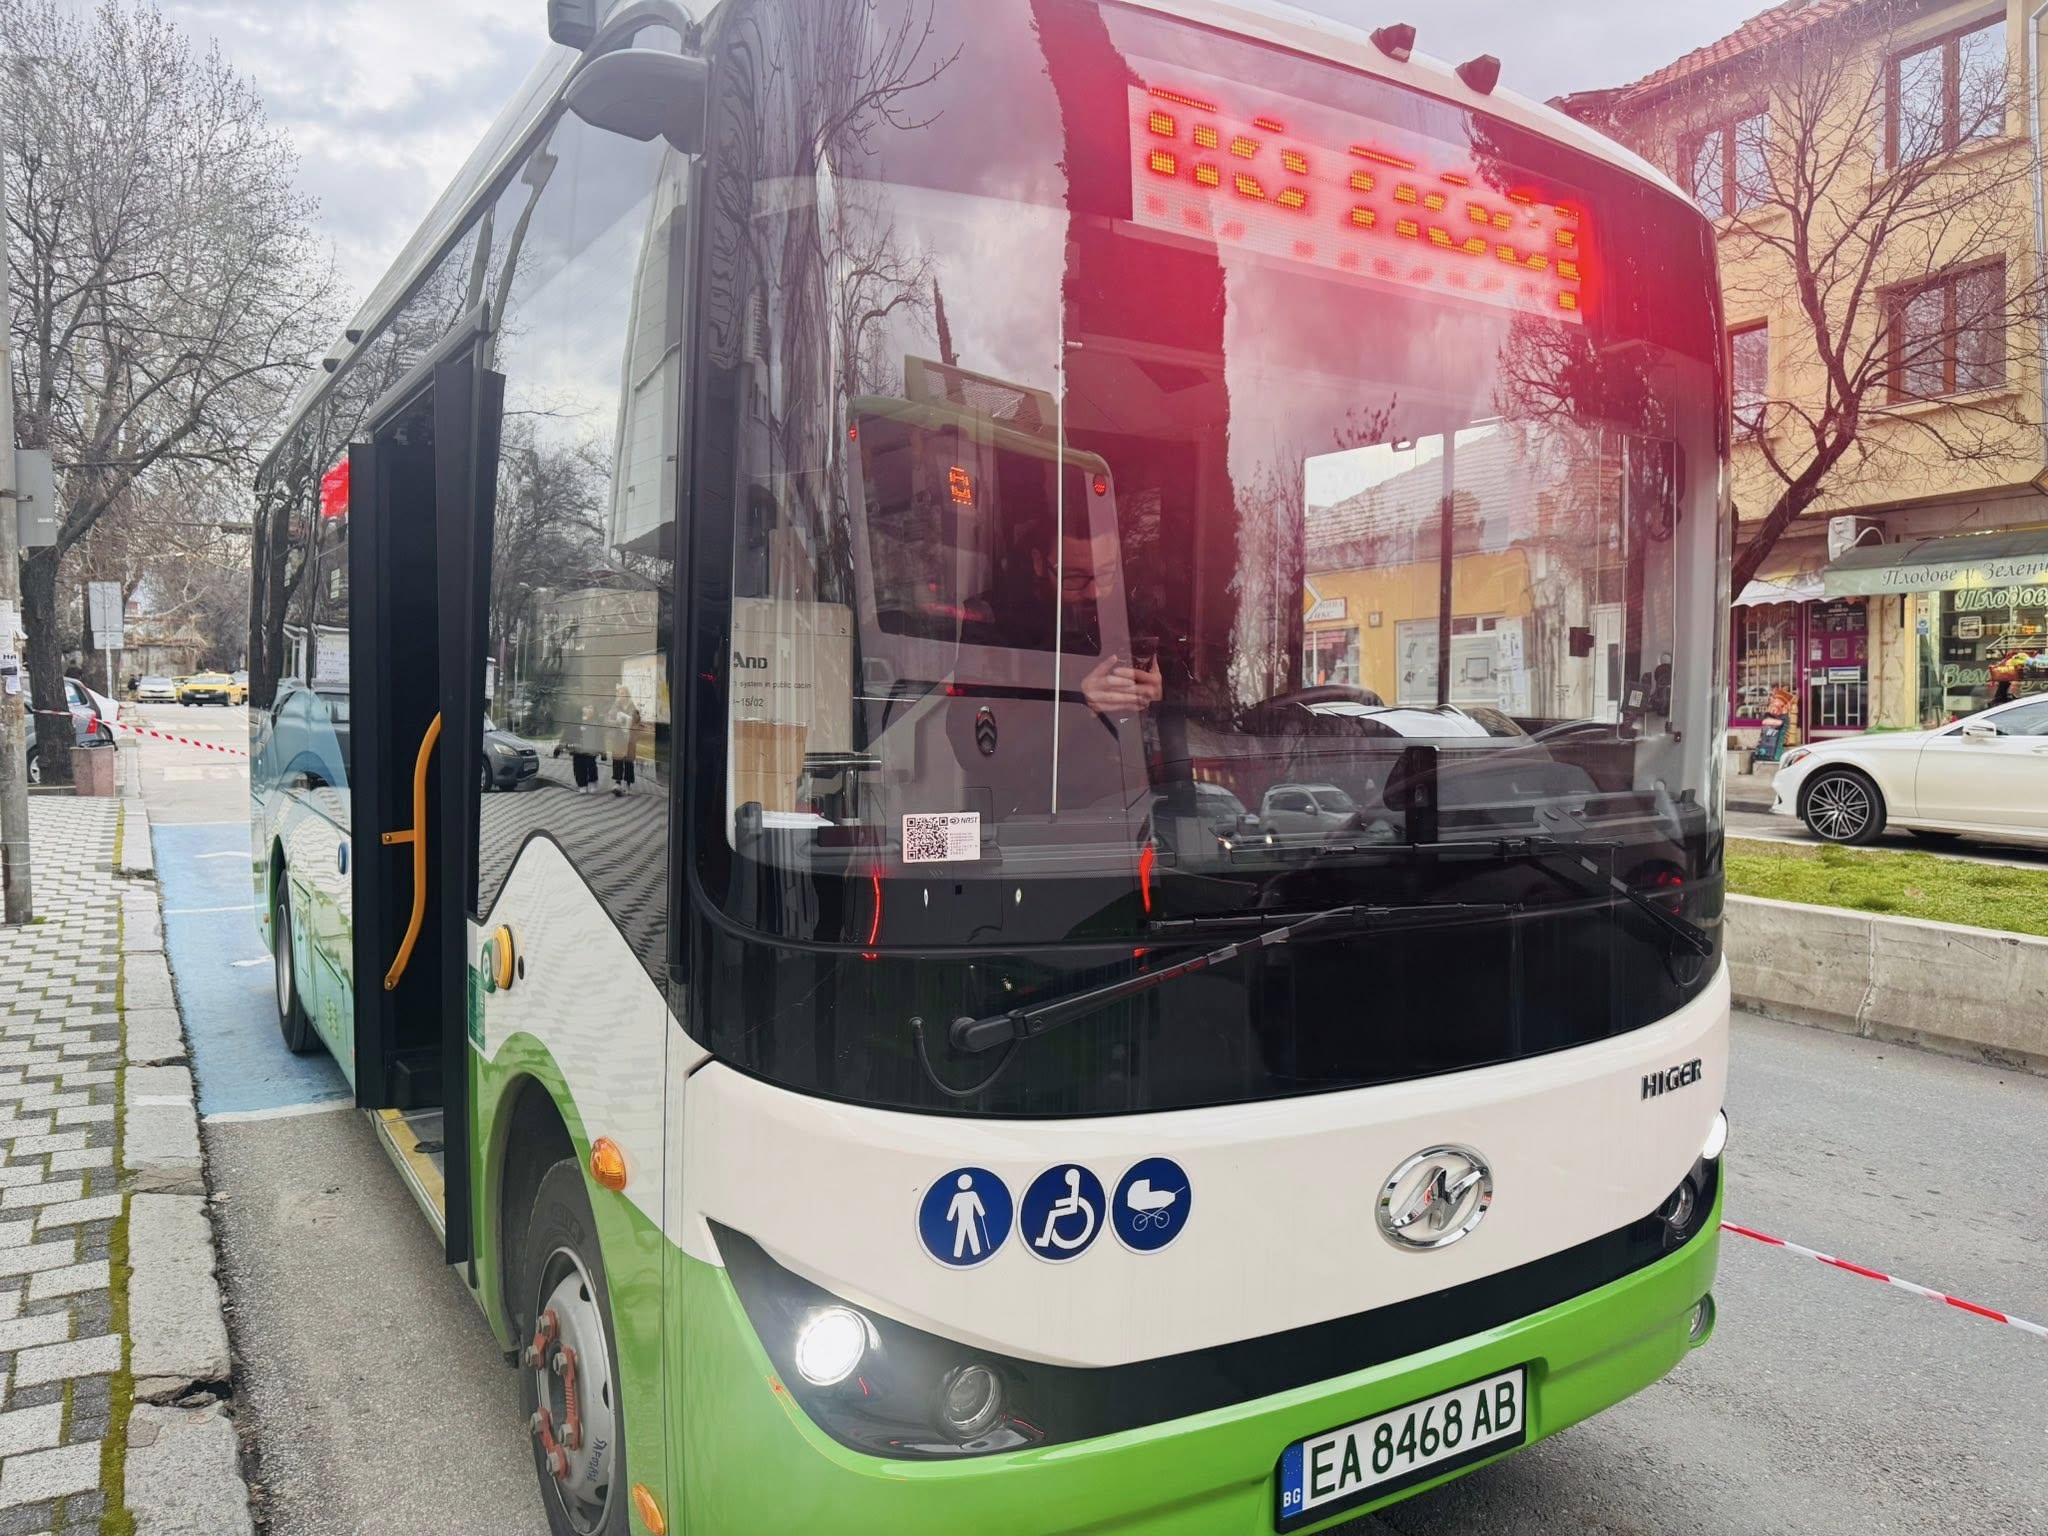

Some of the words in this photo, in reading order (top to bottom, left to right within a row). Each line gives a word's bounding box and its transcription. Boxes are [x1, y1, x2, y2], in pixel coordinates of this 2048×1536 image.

[1882, 566, 1958, 587] Плодове
[1641, 1057, 1702, 1102] HIGER
[1310, 1433, 1363, 1500] EA
[1372, 1398, 1463, 1475] 8468
[1471, 1380, 1516, 1441] AB
[1282, 1487, 1301, 1508] BG
